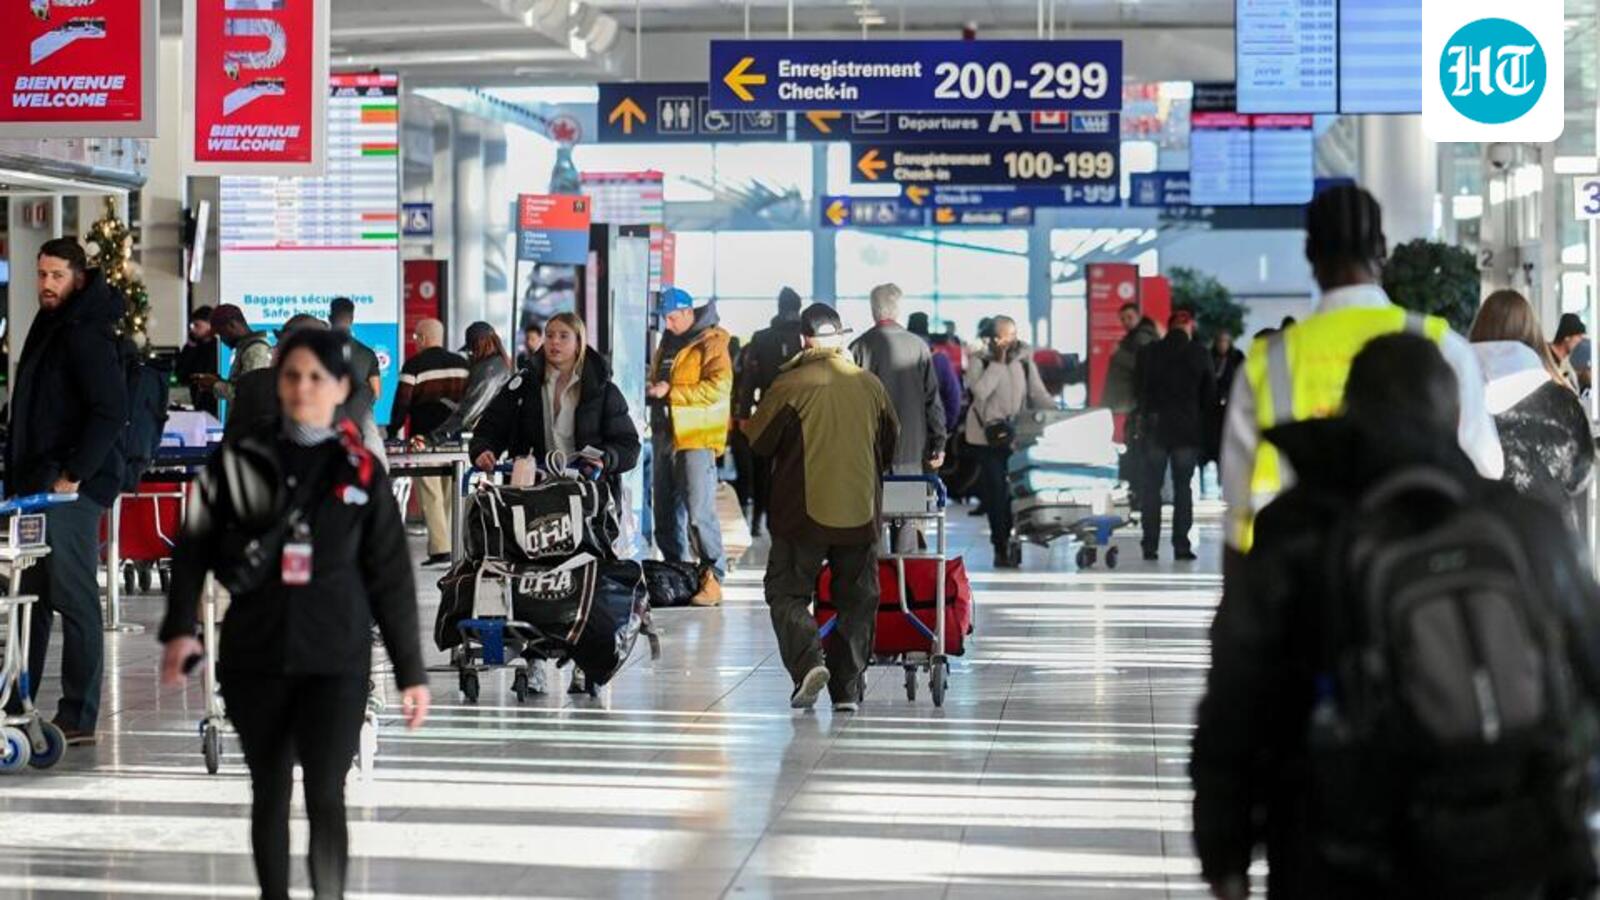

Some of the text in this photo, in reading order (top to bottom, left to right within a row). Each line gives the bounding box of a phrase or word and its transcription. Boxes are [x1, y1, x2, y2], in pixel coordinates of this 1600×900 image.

[15, 75, 126, 91] BIENVENUE
[778, 60, 1108, 99] Enregistrement 200-299
[778, 82, 858, 100] Check-in
[12, 92, 109, 108] WELCOME
[898, 111, 1023, 133] Departures A
[210, 124, 300, 138] BIENVENUE
[207, 138, 286, 152] WELCOME
[893, 152, 1114, 178] Enregistrement 100-199
[244, 294, 297, 306] Bagages
[262, 308, 290, 319] Safe
